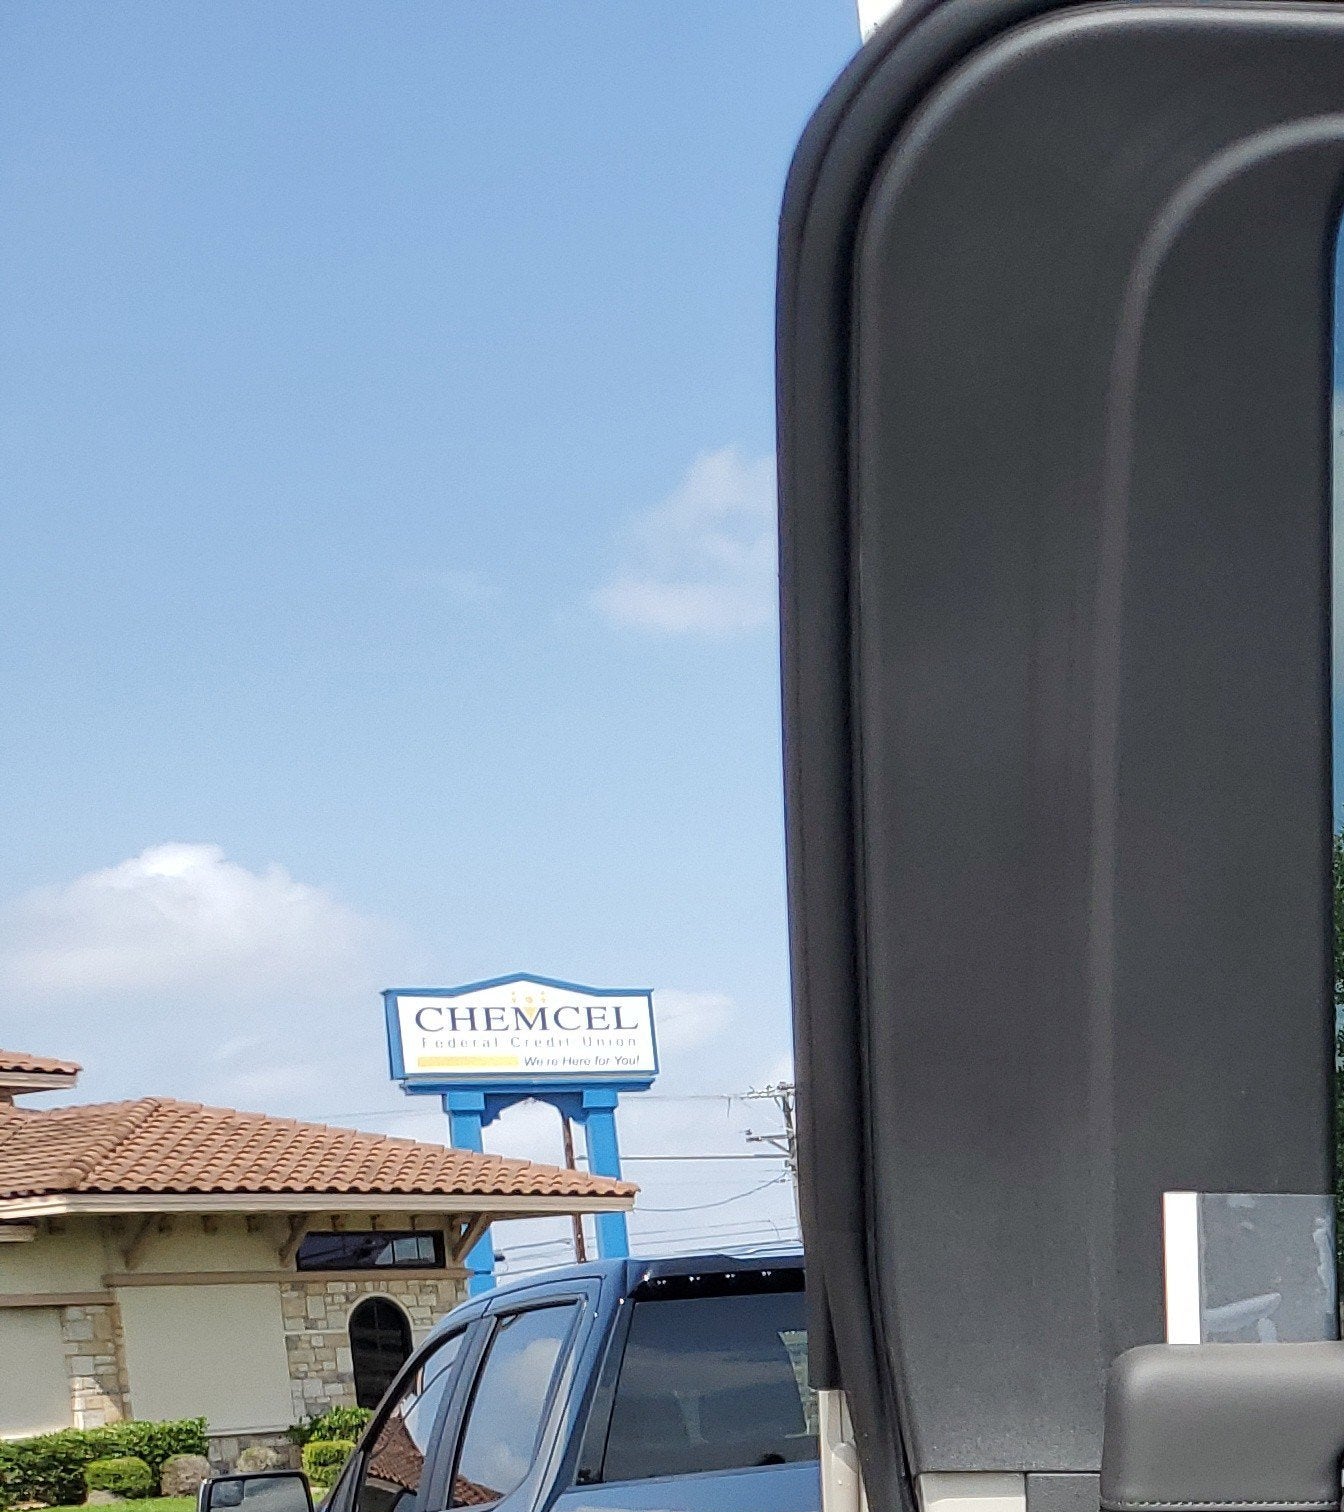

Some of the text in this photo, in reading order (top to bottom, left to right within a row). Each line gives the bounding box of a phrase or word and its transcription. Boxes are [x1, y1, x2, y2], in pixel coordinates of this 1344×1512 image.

[415, 1006, 639, 1032] CHEMCEL
[422, 1036, 636, 1049] Federal Credit Union
